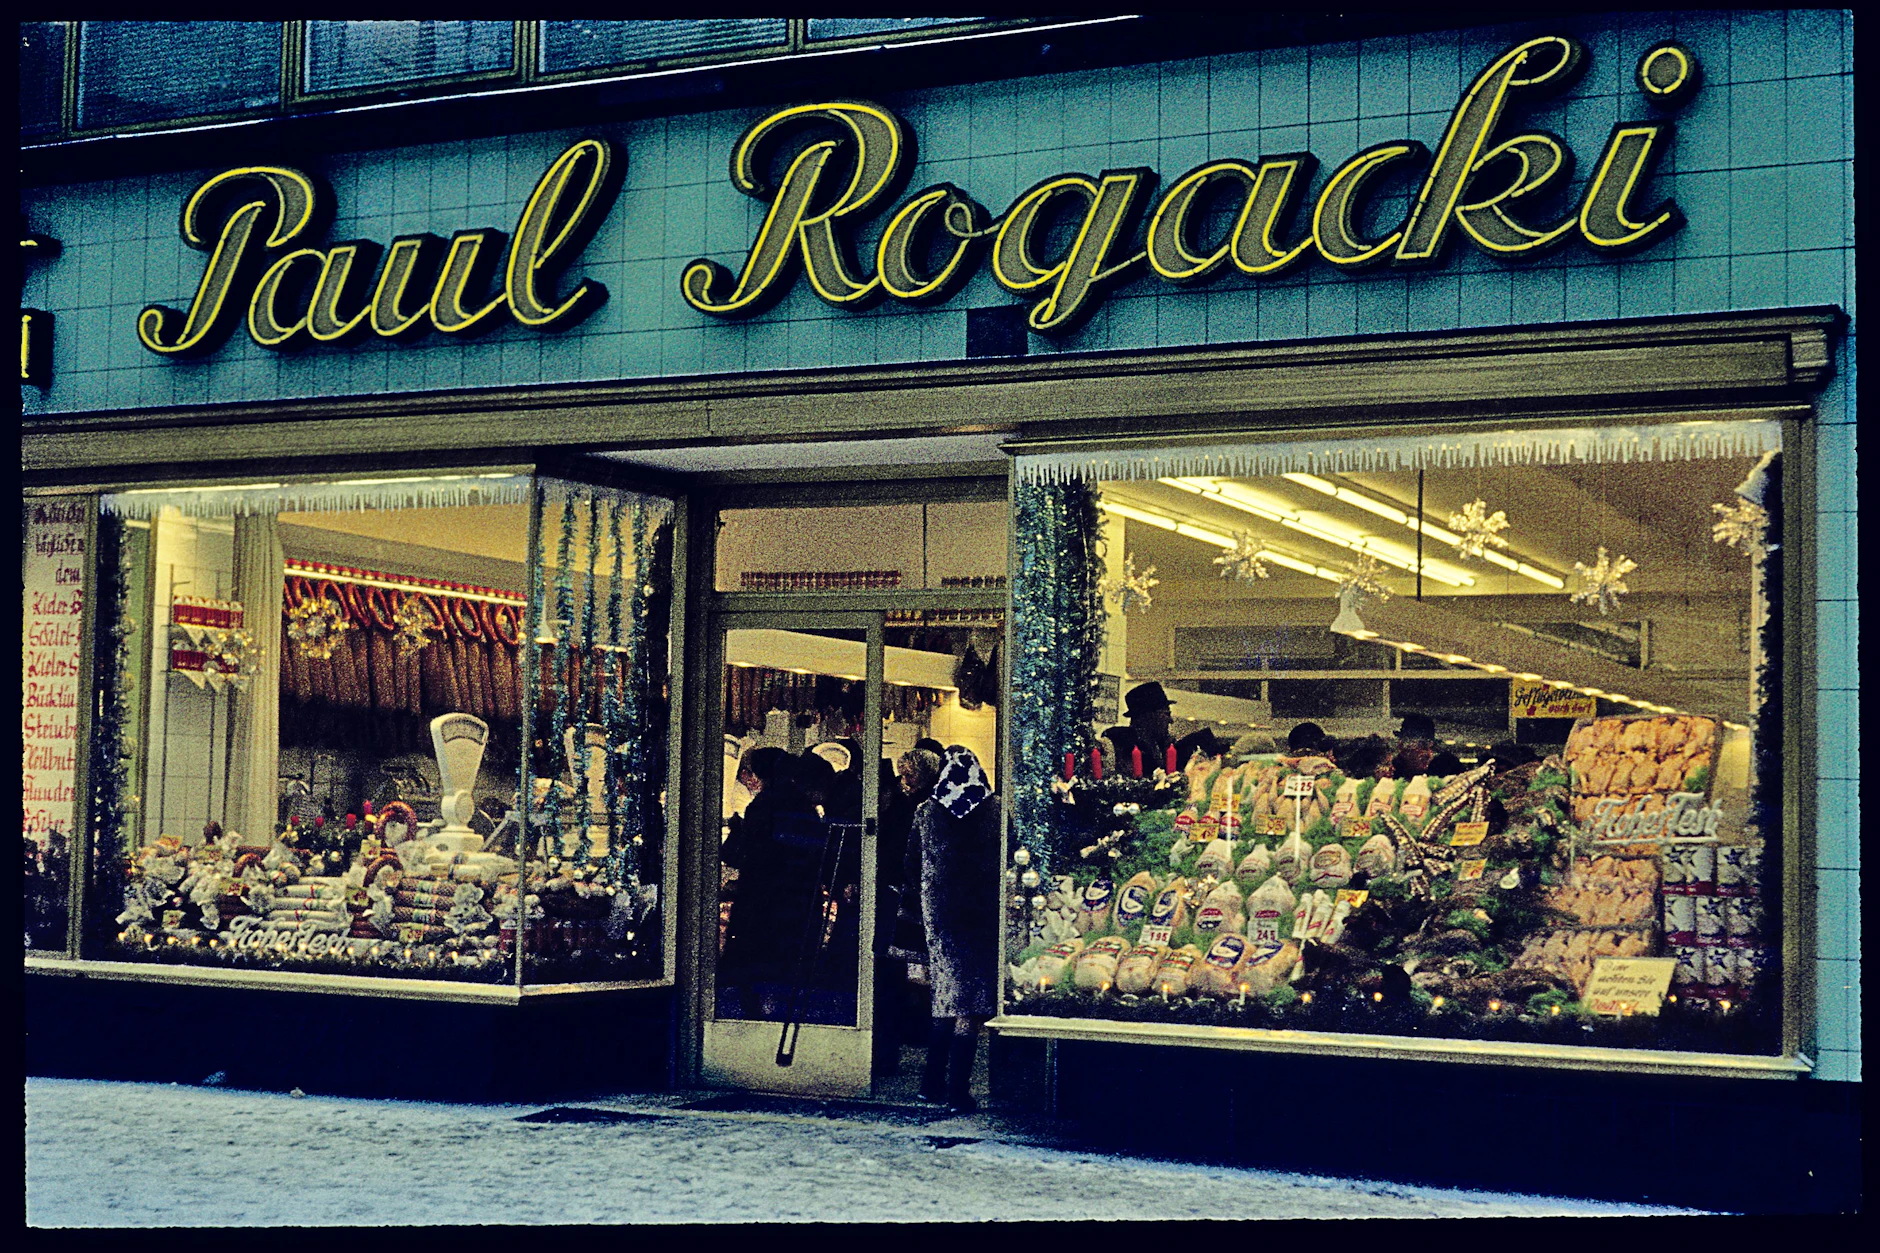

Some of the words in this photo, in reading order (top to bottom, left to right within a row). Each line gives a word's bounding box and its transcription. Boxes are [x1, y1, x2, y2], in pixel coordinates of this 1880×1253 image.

[138, 138, 600, 353] Paul
[681, 34, 1682, 334] Rogacki
[31, 590, 68, 615] Kieler
[27, 650, 68, 679] Kieler
[1666, 791, 1723, 840] Fest
